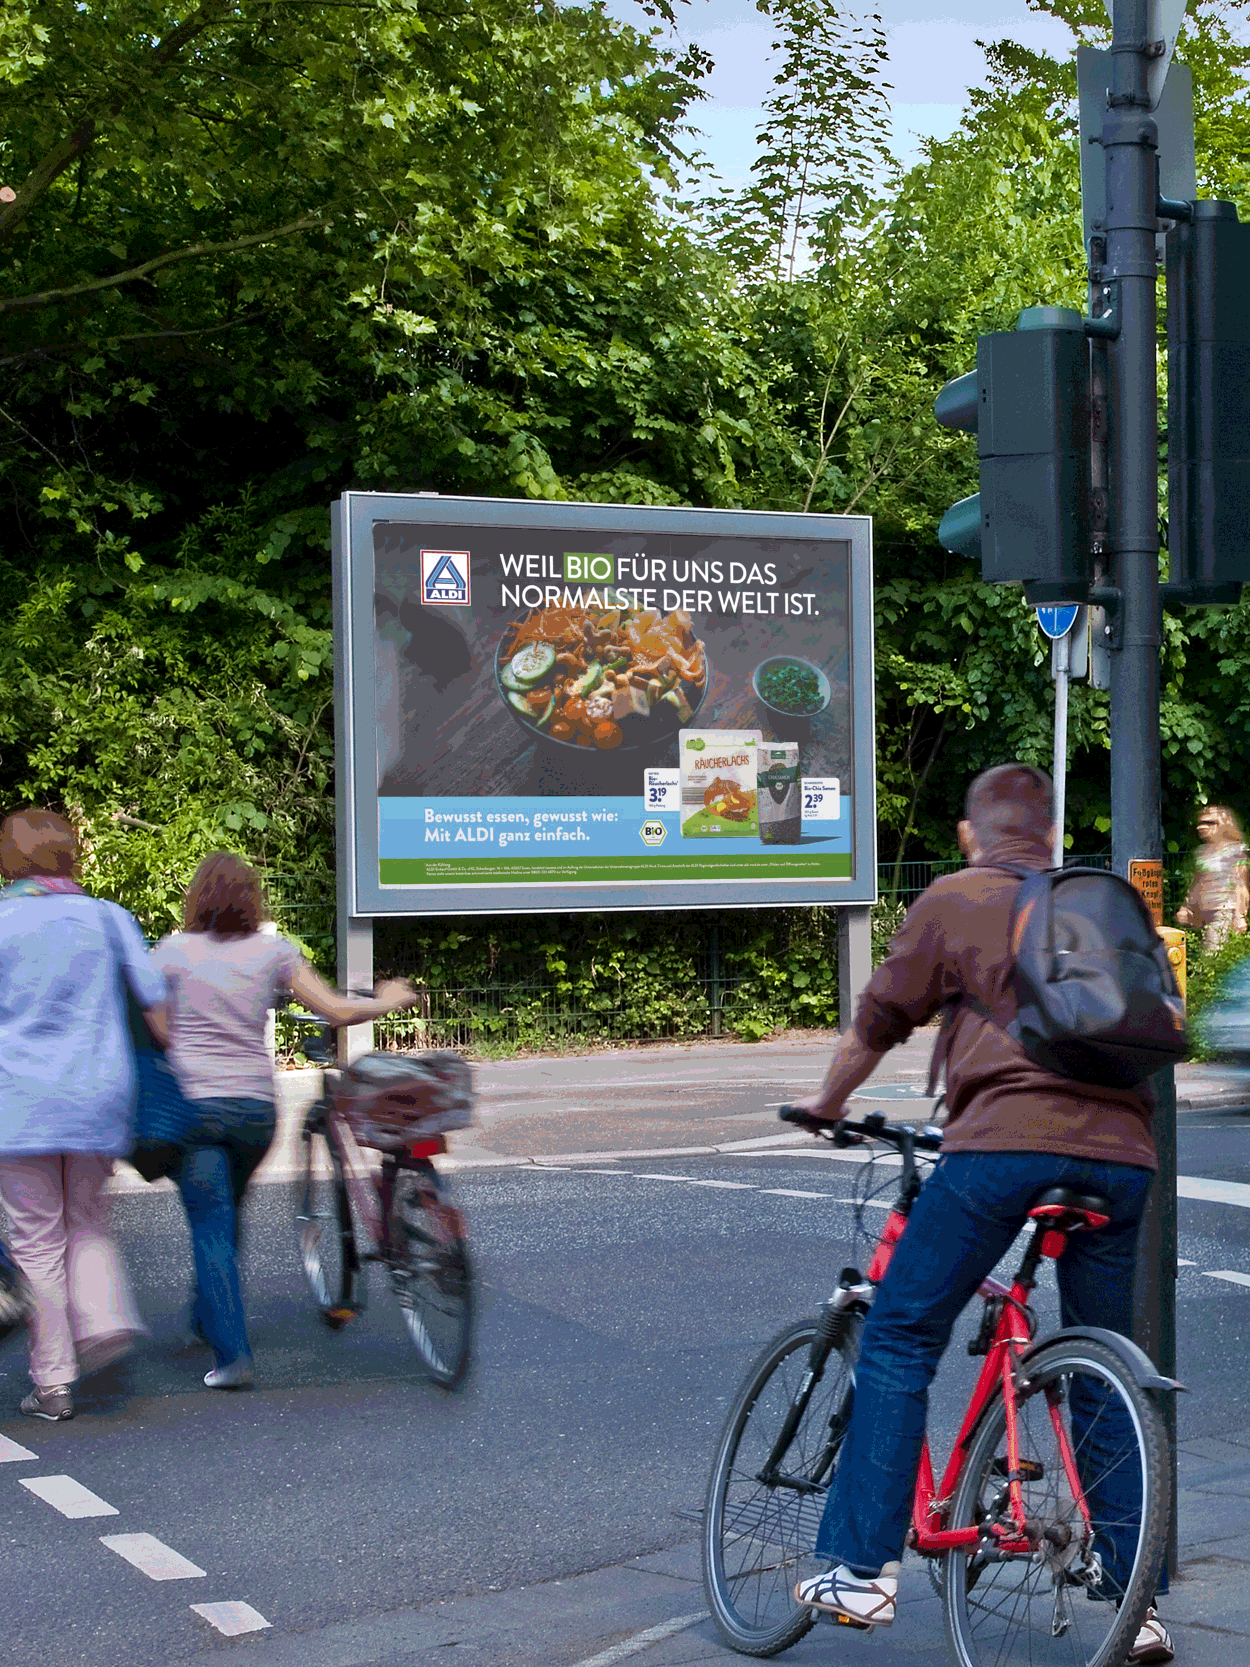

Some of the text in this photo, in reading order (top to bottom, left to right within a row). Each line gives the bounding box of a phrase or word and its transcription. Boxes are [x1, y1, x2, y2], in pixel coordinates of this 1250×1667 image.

[499, 552, 778, 586] WEIL BIO FÜR UNS DAS
[430, 589, 463, 599] ALDI
[501, 584, 820, 616] NORMALSTE DER WELT IST.
[694, 755, 750, 771] RÄUCHERLACHS
[424, 808, 619, 828] Bewusst essen, gewusst wie:
[424, 826, 591, 847] Mit ALDI ganz einfach.
[1142, 880, 1159, 889] roten
